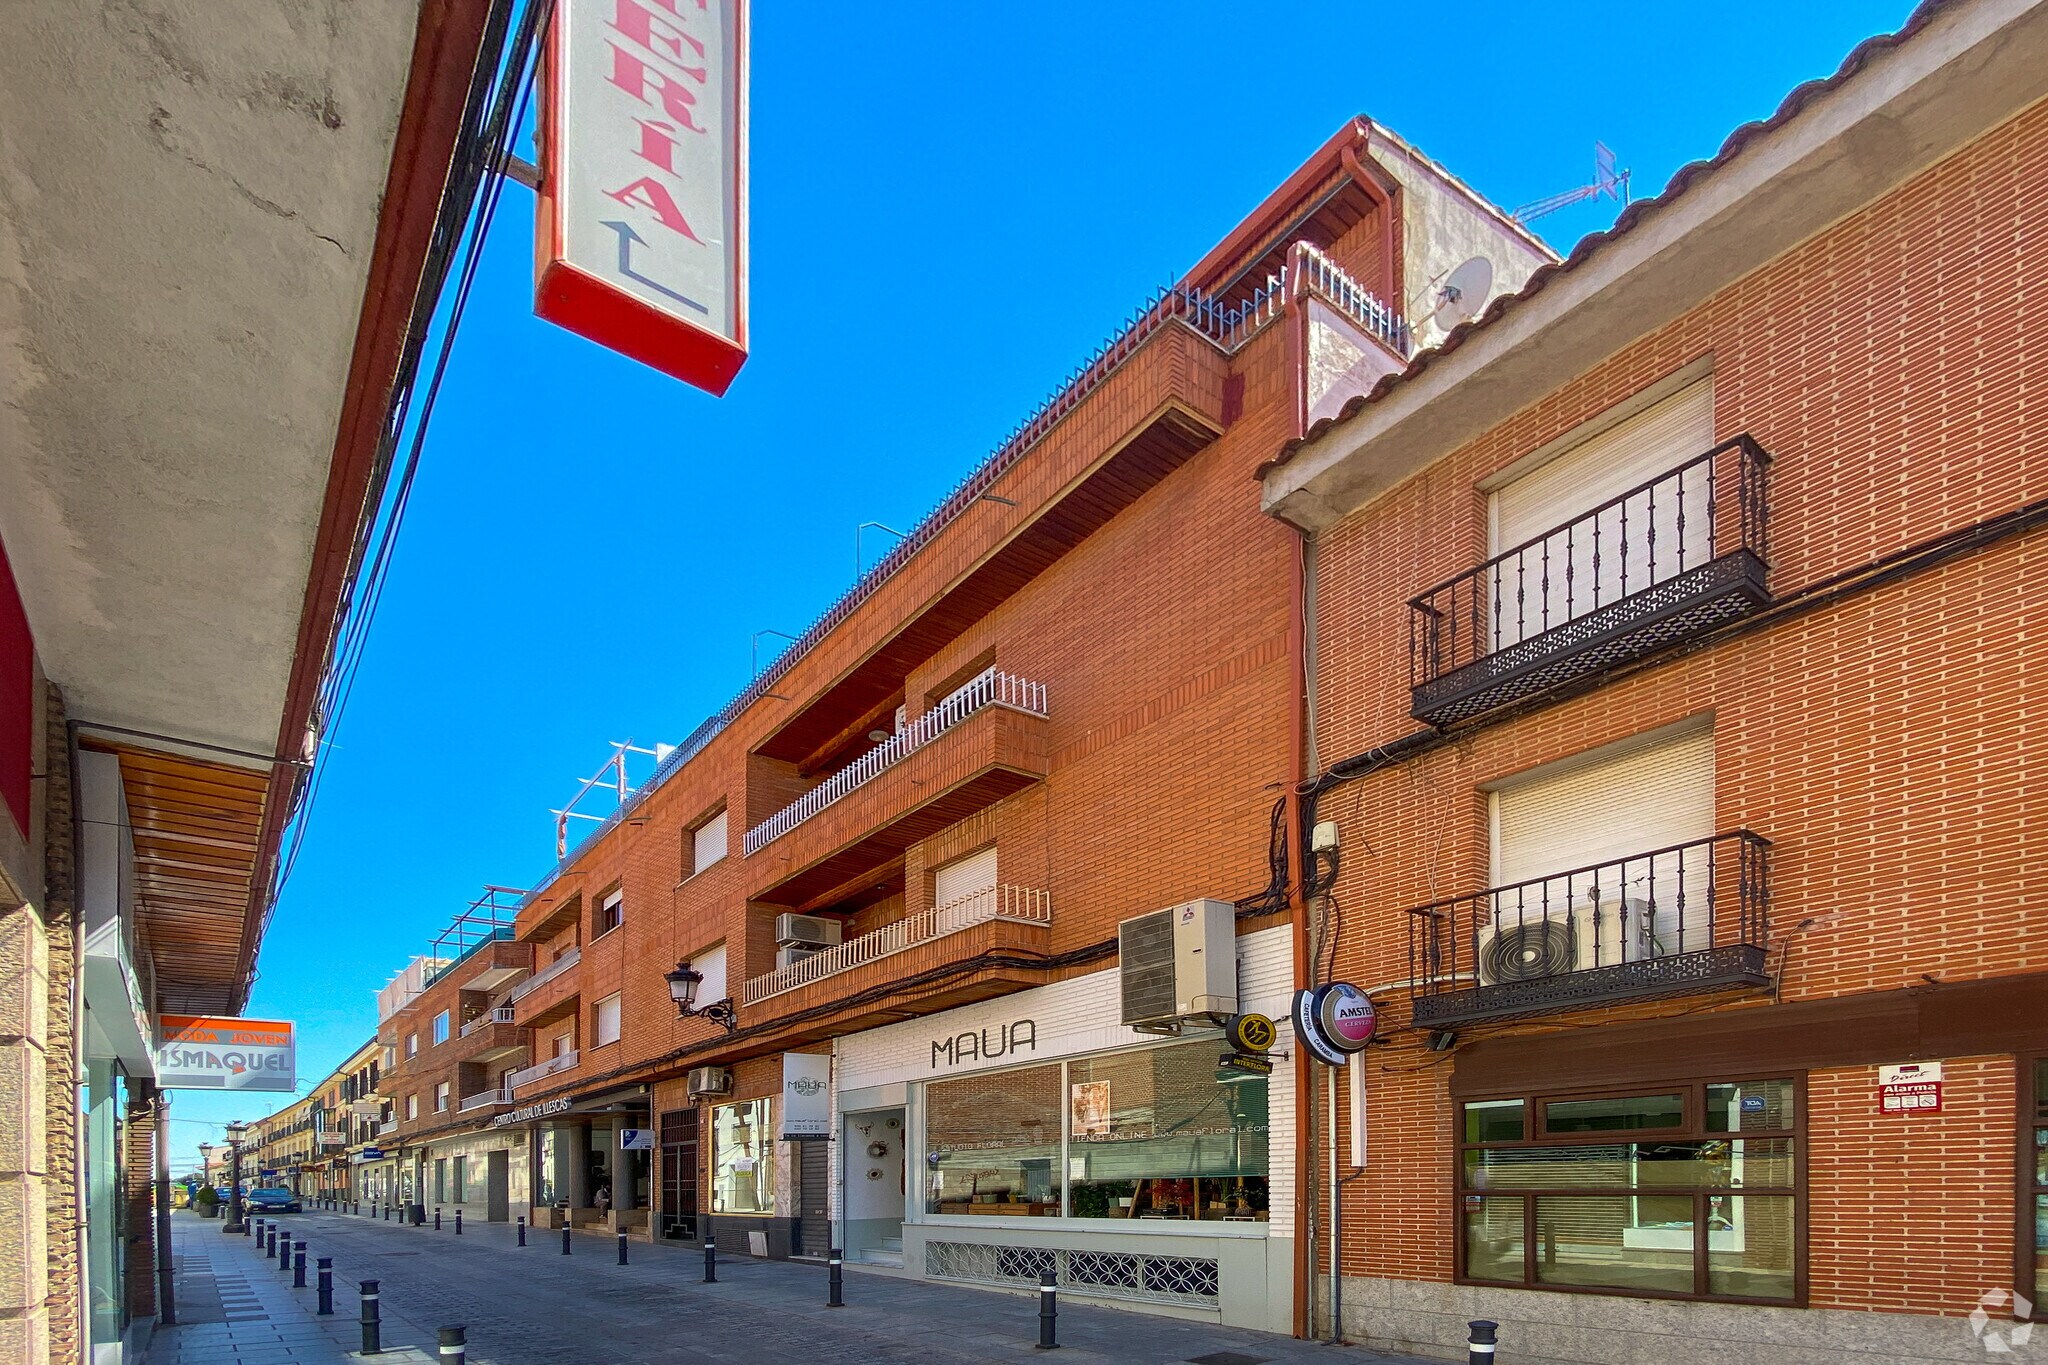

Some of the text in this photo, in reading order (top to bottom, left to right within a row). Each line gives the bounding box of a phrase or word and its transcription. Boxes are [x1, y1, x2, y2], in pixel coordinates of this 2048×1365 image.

[601, 0, 706, 247] ERÍA
[1339, 1006, 1373, 1018] AMSTEL
[164, 1030, 288, 1046] MODA JOVEN
[932, 1019, 1035, 1068] MAUA
[1313, 1038, 1333, 1059] CARAMBA
[160, 1049, 290, 1075] ISMAQUEL
[1233, 1059, 1270, 1072] INTERFLORA
[787, 1081, 827, 1090] MAUA
[1883, 1084, 1937, 1093] Alarma
[534, 1104, 542, 1117] DE
[1109, 1130, 1147, 1141] ONLINE
